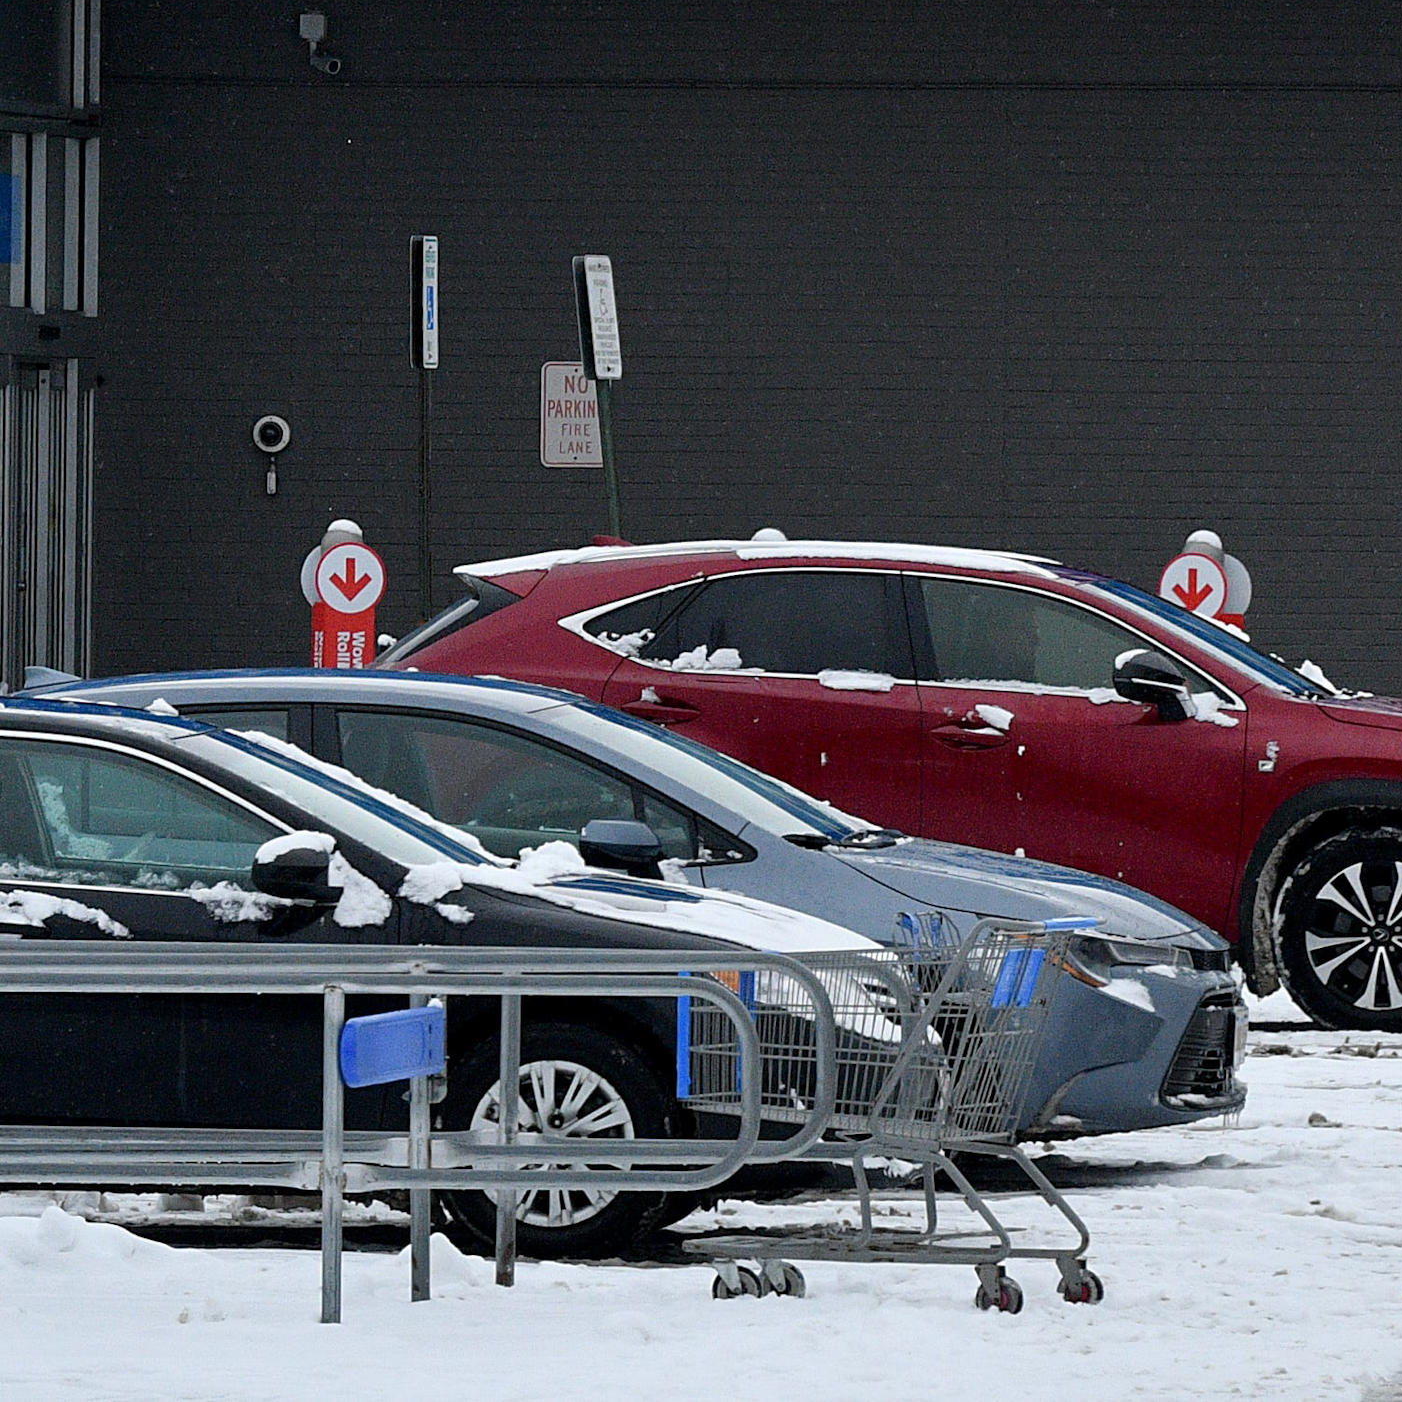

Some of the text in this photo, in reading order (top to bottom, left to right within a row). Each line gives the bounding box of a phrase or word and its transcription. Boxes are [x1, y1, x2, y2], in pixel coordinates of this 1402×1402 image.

[564, 375, 589, 394] NO
[547, 399, 596, 418] PARKIN
[561, 423, 591, 437] FIRE
[559, 441, 593, 454] LANE
